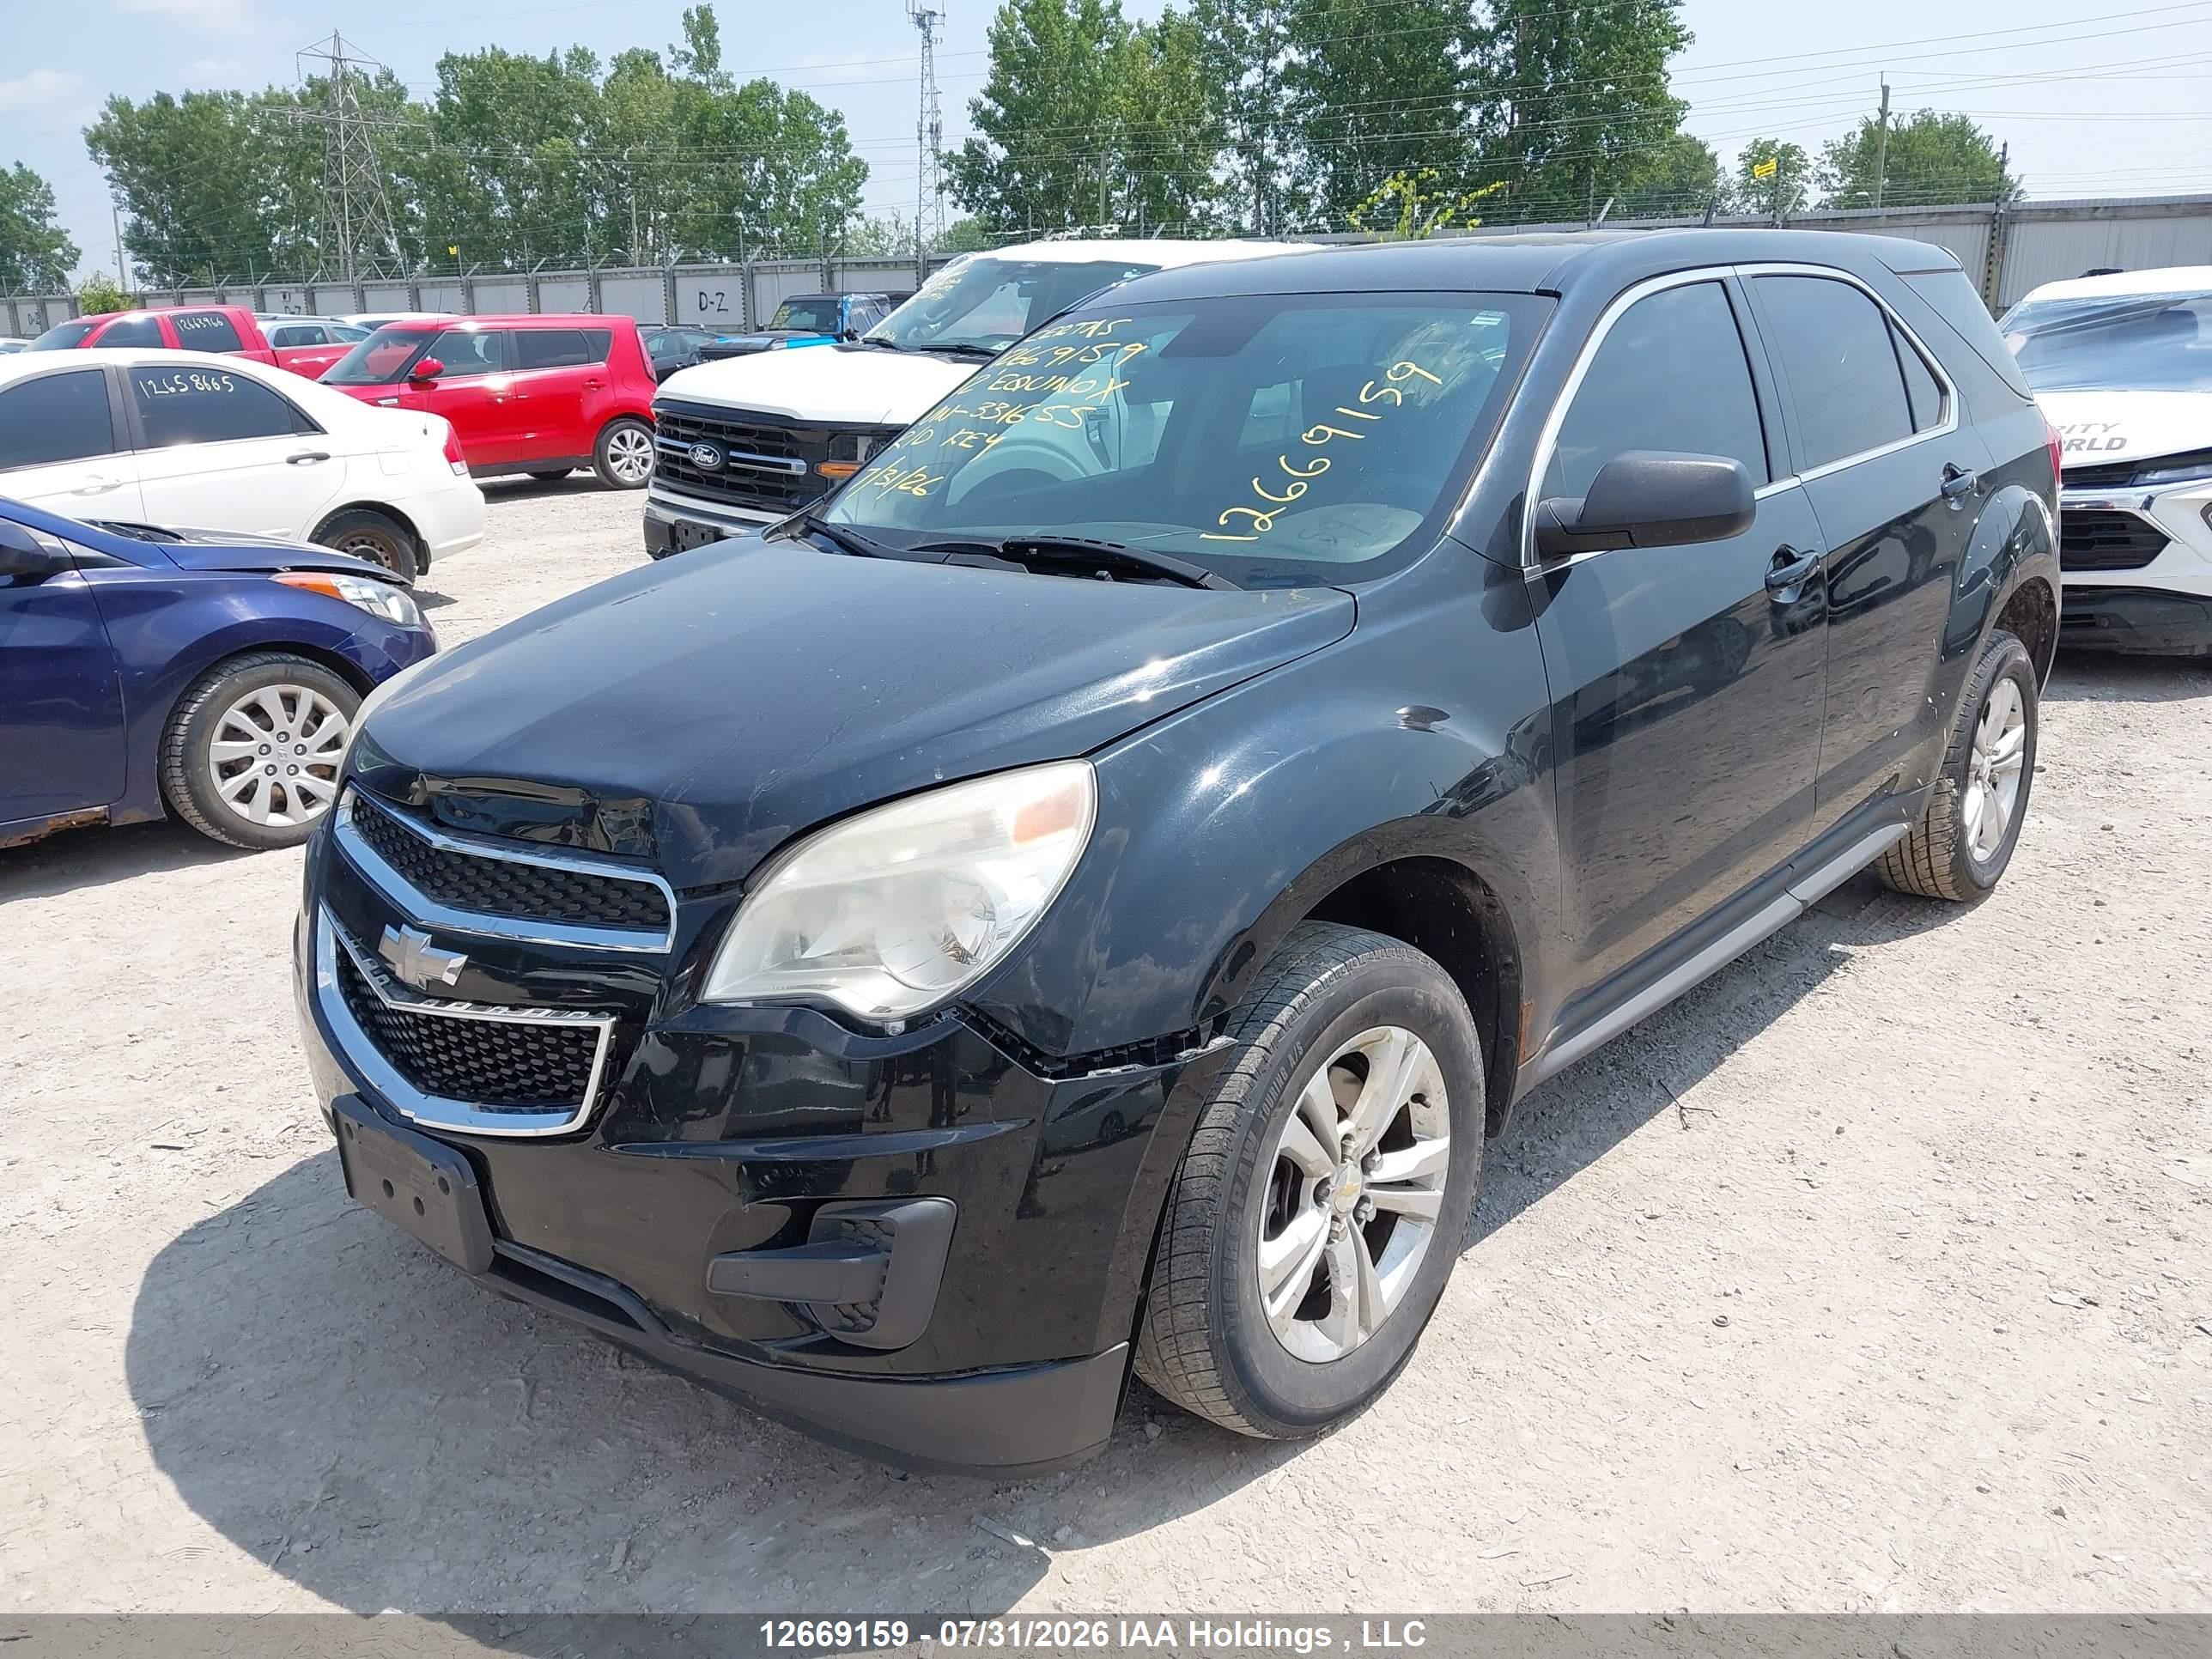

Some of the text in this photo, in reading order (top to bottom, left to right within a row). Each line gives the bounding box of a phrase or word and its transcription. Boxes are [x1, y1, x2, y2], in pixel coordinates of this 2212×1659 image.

[176, 317, 223, 331] 12663966
[988, 343, 1148, 368] 12669159
[139, 374, 234, 398] 12658665
[693, 447, 714, 464] Ford
[940, 428, 1006, 464] KEY
[1200, 361, 1443, 540] 12669159
[2063, 437, 2127, 452] RLD
[845, 455, 945, 501] 7/31/26
[1259, 1066, 1288, 1122] TOURING
[1288, 1039, 1304, 1069] A/S
